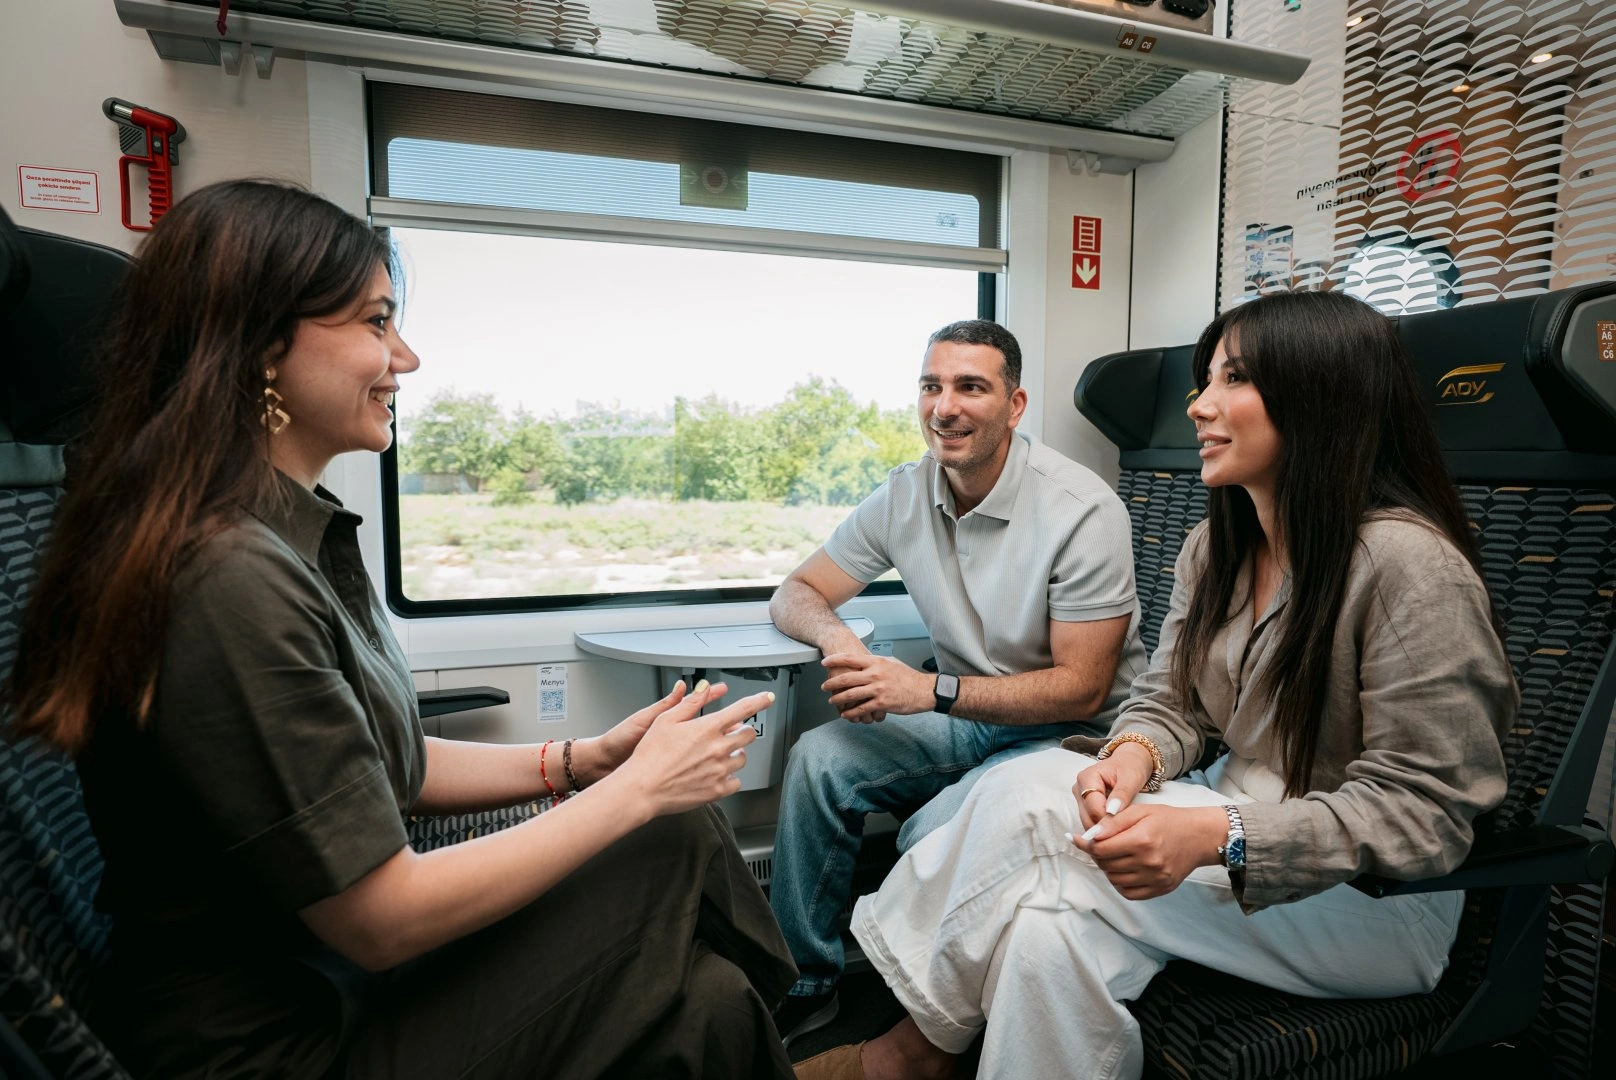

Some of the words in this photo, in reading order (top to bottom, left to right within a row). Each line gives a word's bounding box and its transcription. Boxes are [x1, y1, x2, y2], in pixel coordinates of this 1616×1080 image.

[1122, 38, 1134, 46] A6
[1141, 41, 1152, 50] C6
[1601, 331, 1613, 341] A6
[1603, 349, 1614, 359] C6
[1441, 380, 1487, 398] ADY
[540, 679, 565, 687] Menyu
